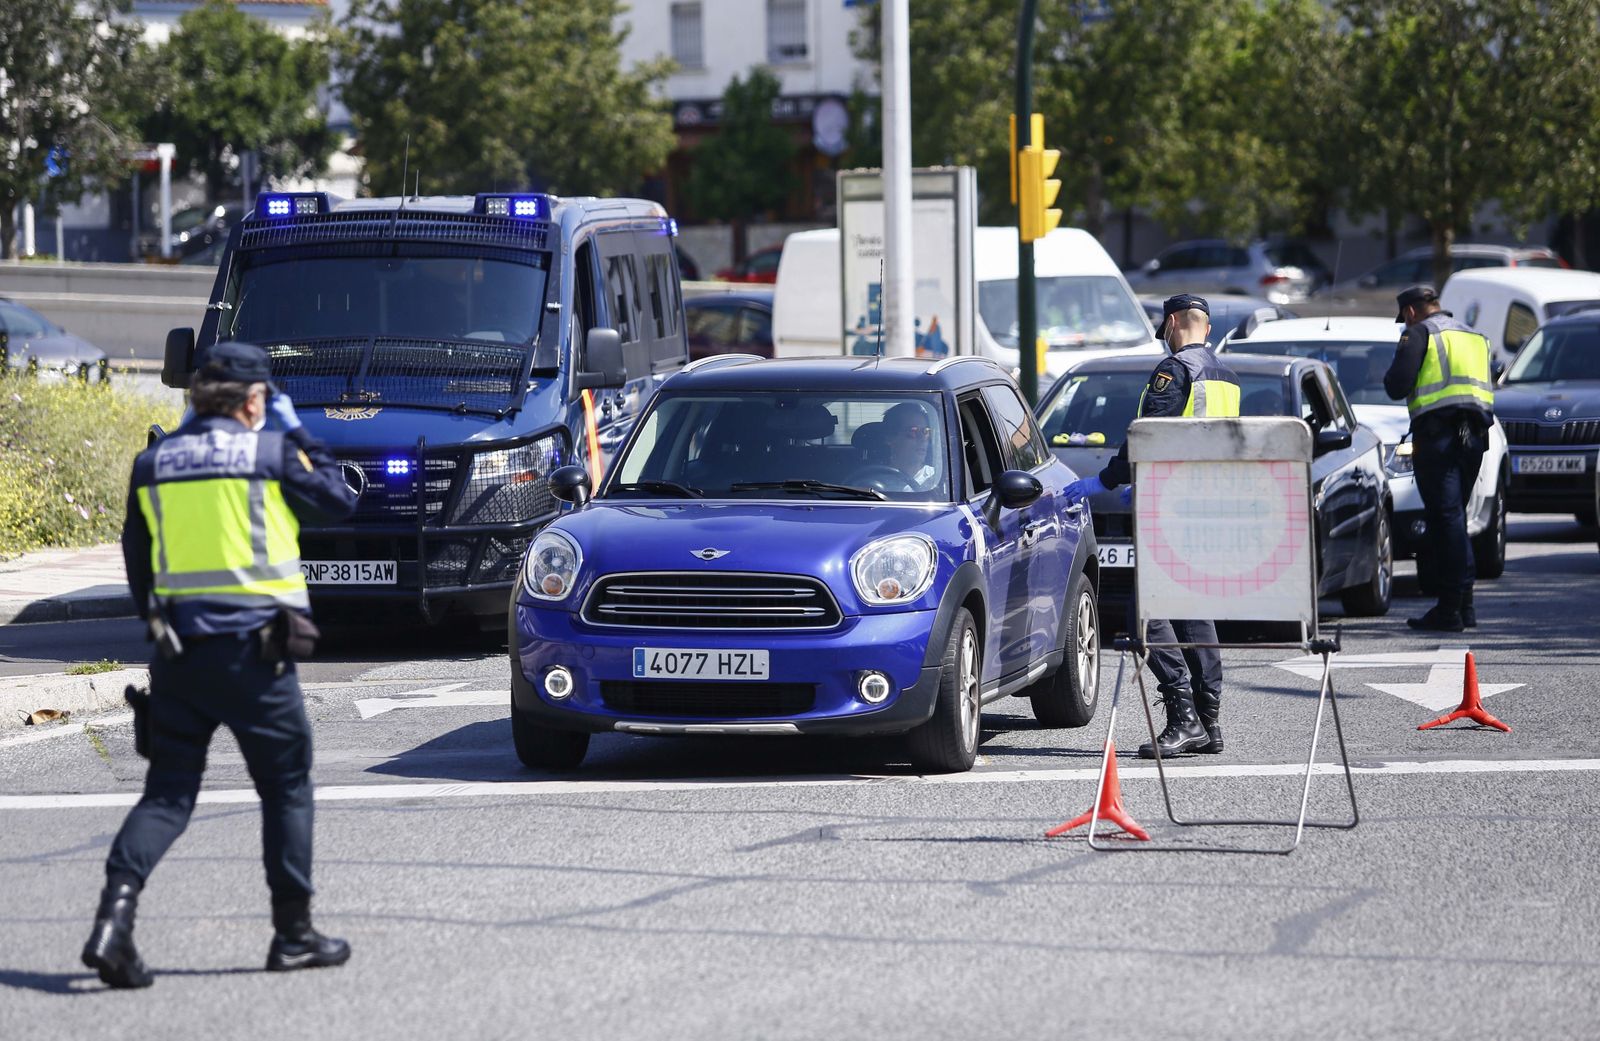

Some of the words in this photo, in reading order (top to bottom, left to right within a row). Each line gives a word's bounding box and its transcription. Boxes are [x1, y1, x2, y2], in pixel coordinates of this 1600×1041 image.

[1521, 458, 1554, 471] 6520
[1557, 458, 1582, 471] KMK
[650, 652, 709, 674] 4077
[718, 653, 763, 675] HZL
